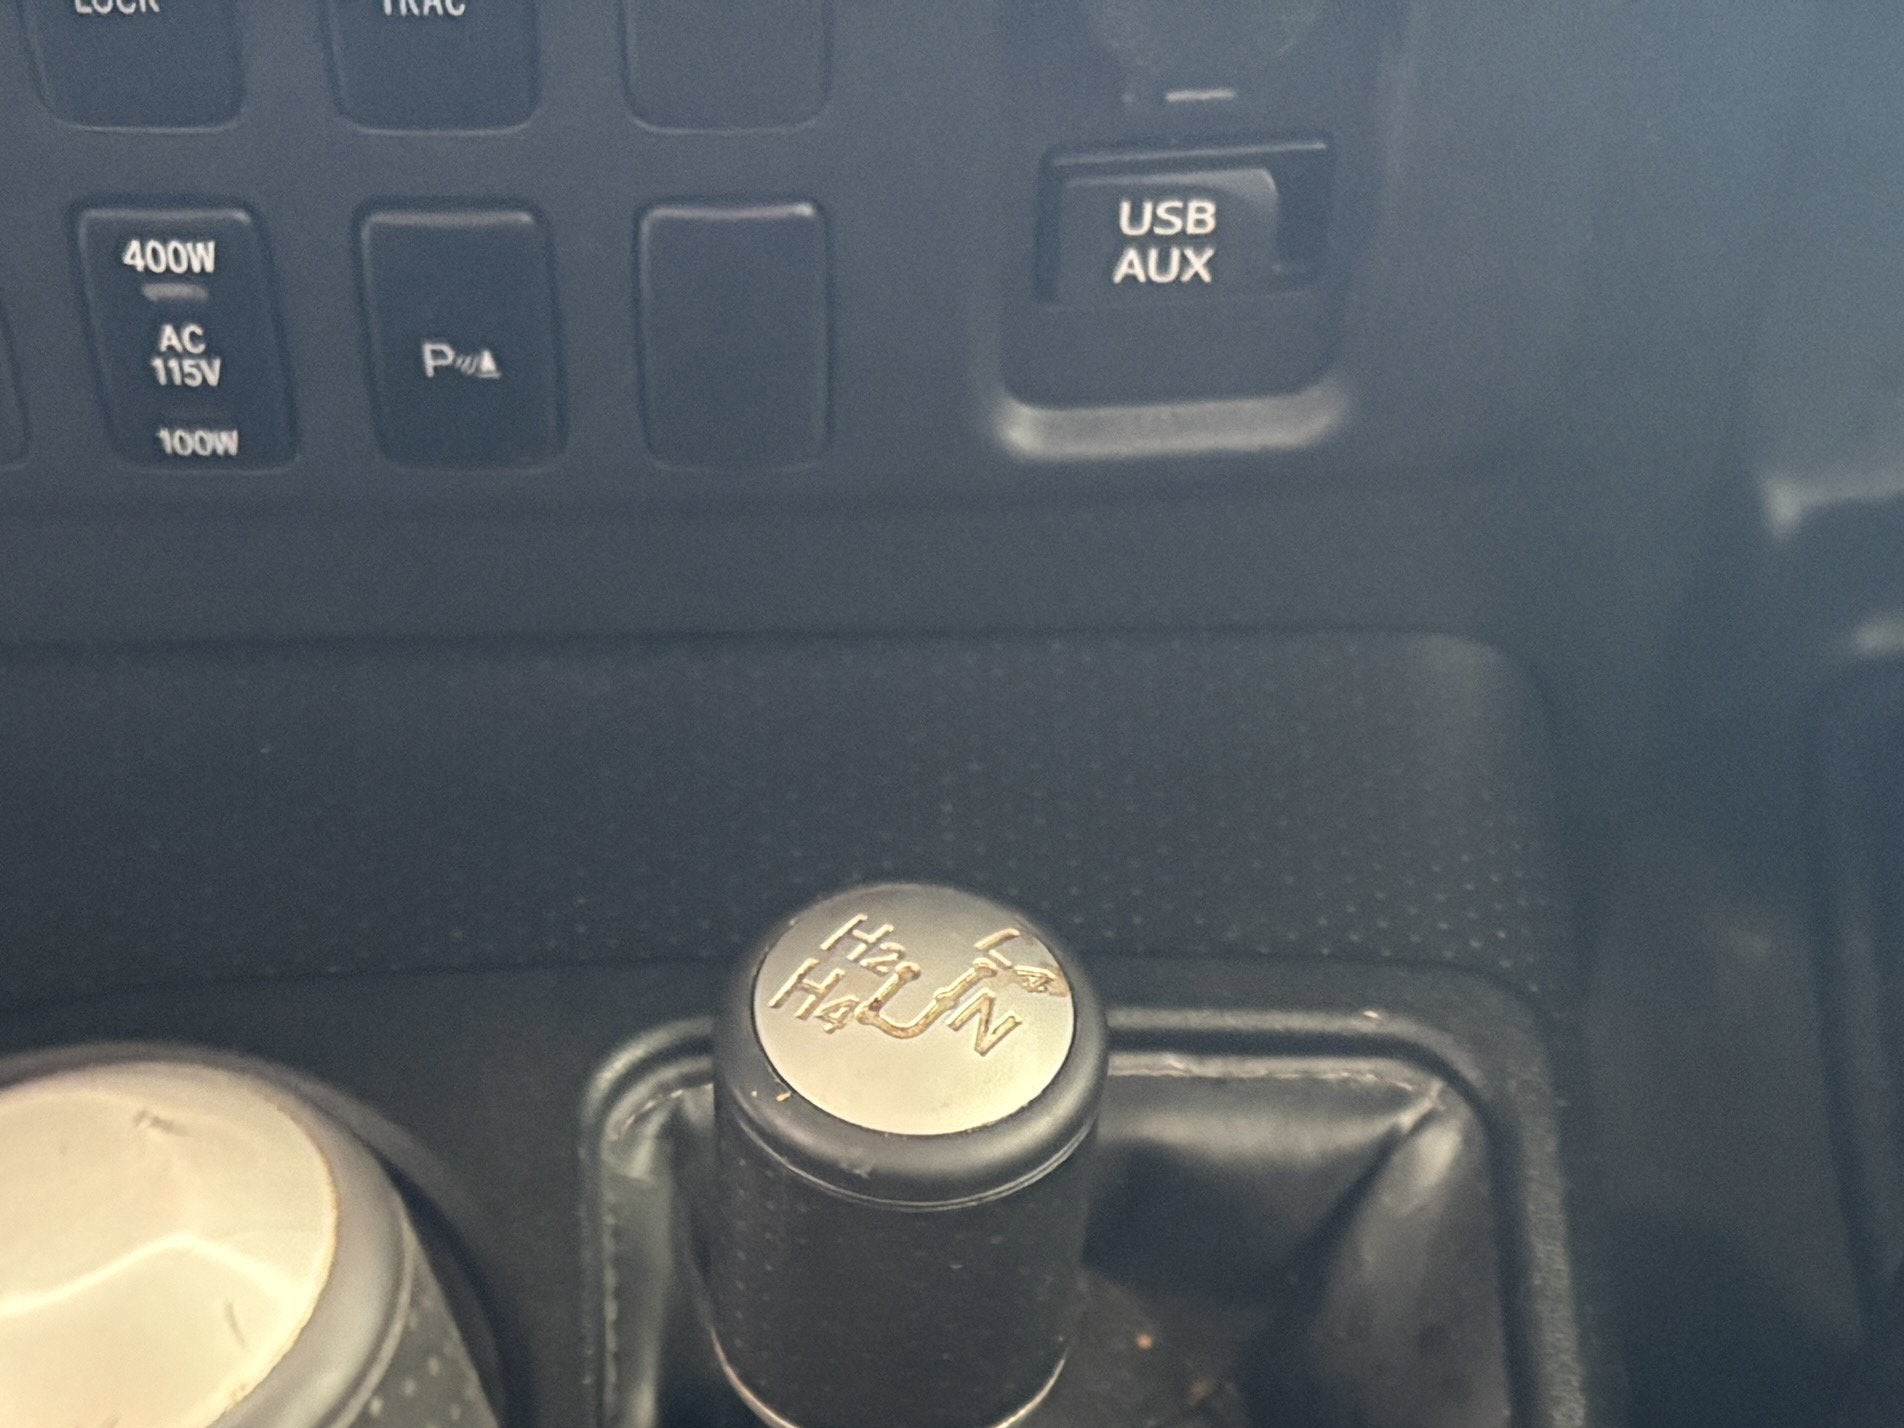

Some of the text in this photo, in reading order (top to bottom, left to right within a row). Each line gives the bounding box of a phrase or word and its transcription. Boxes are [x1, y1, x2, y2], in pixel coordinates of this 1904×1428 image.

[1119, 199, 1217, 236] USB
[122, 239, 216, 274] 400W
[1112, 246, 1215, 284] AUX
[159, 323, 207, 354] AC
[151, 358, 221, 387] 115V
[157, 427, 240, 457] 100W
[820, 912, 906, 977] H2
[767, 957, 860, 1034] H4
[946, 986, 1023, 1057] N
